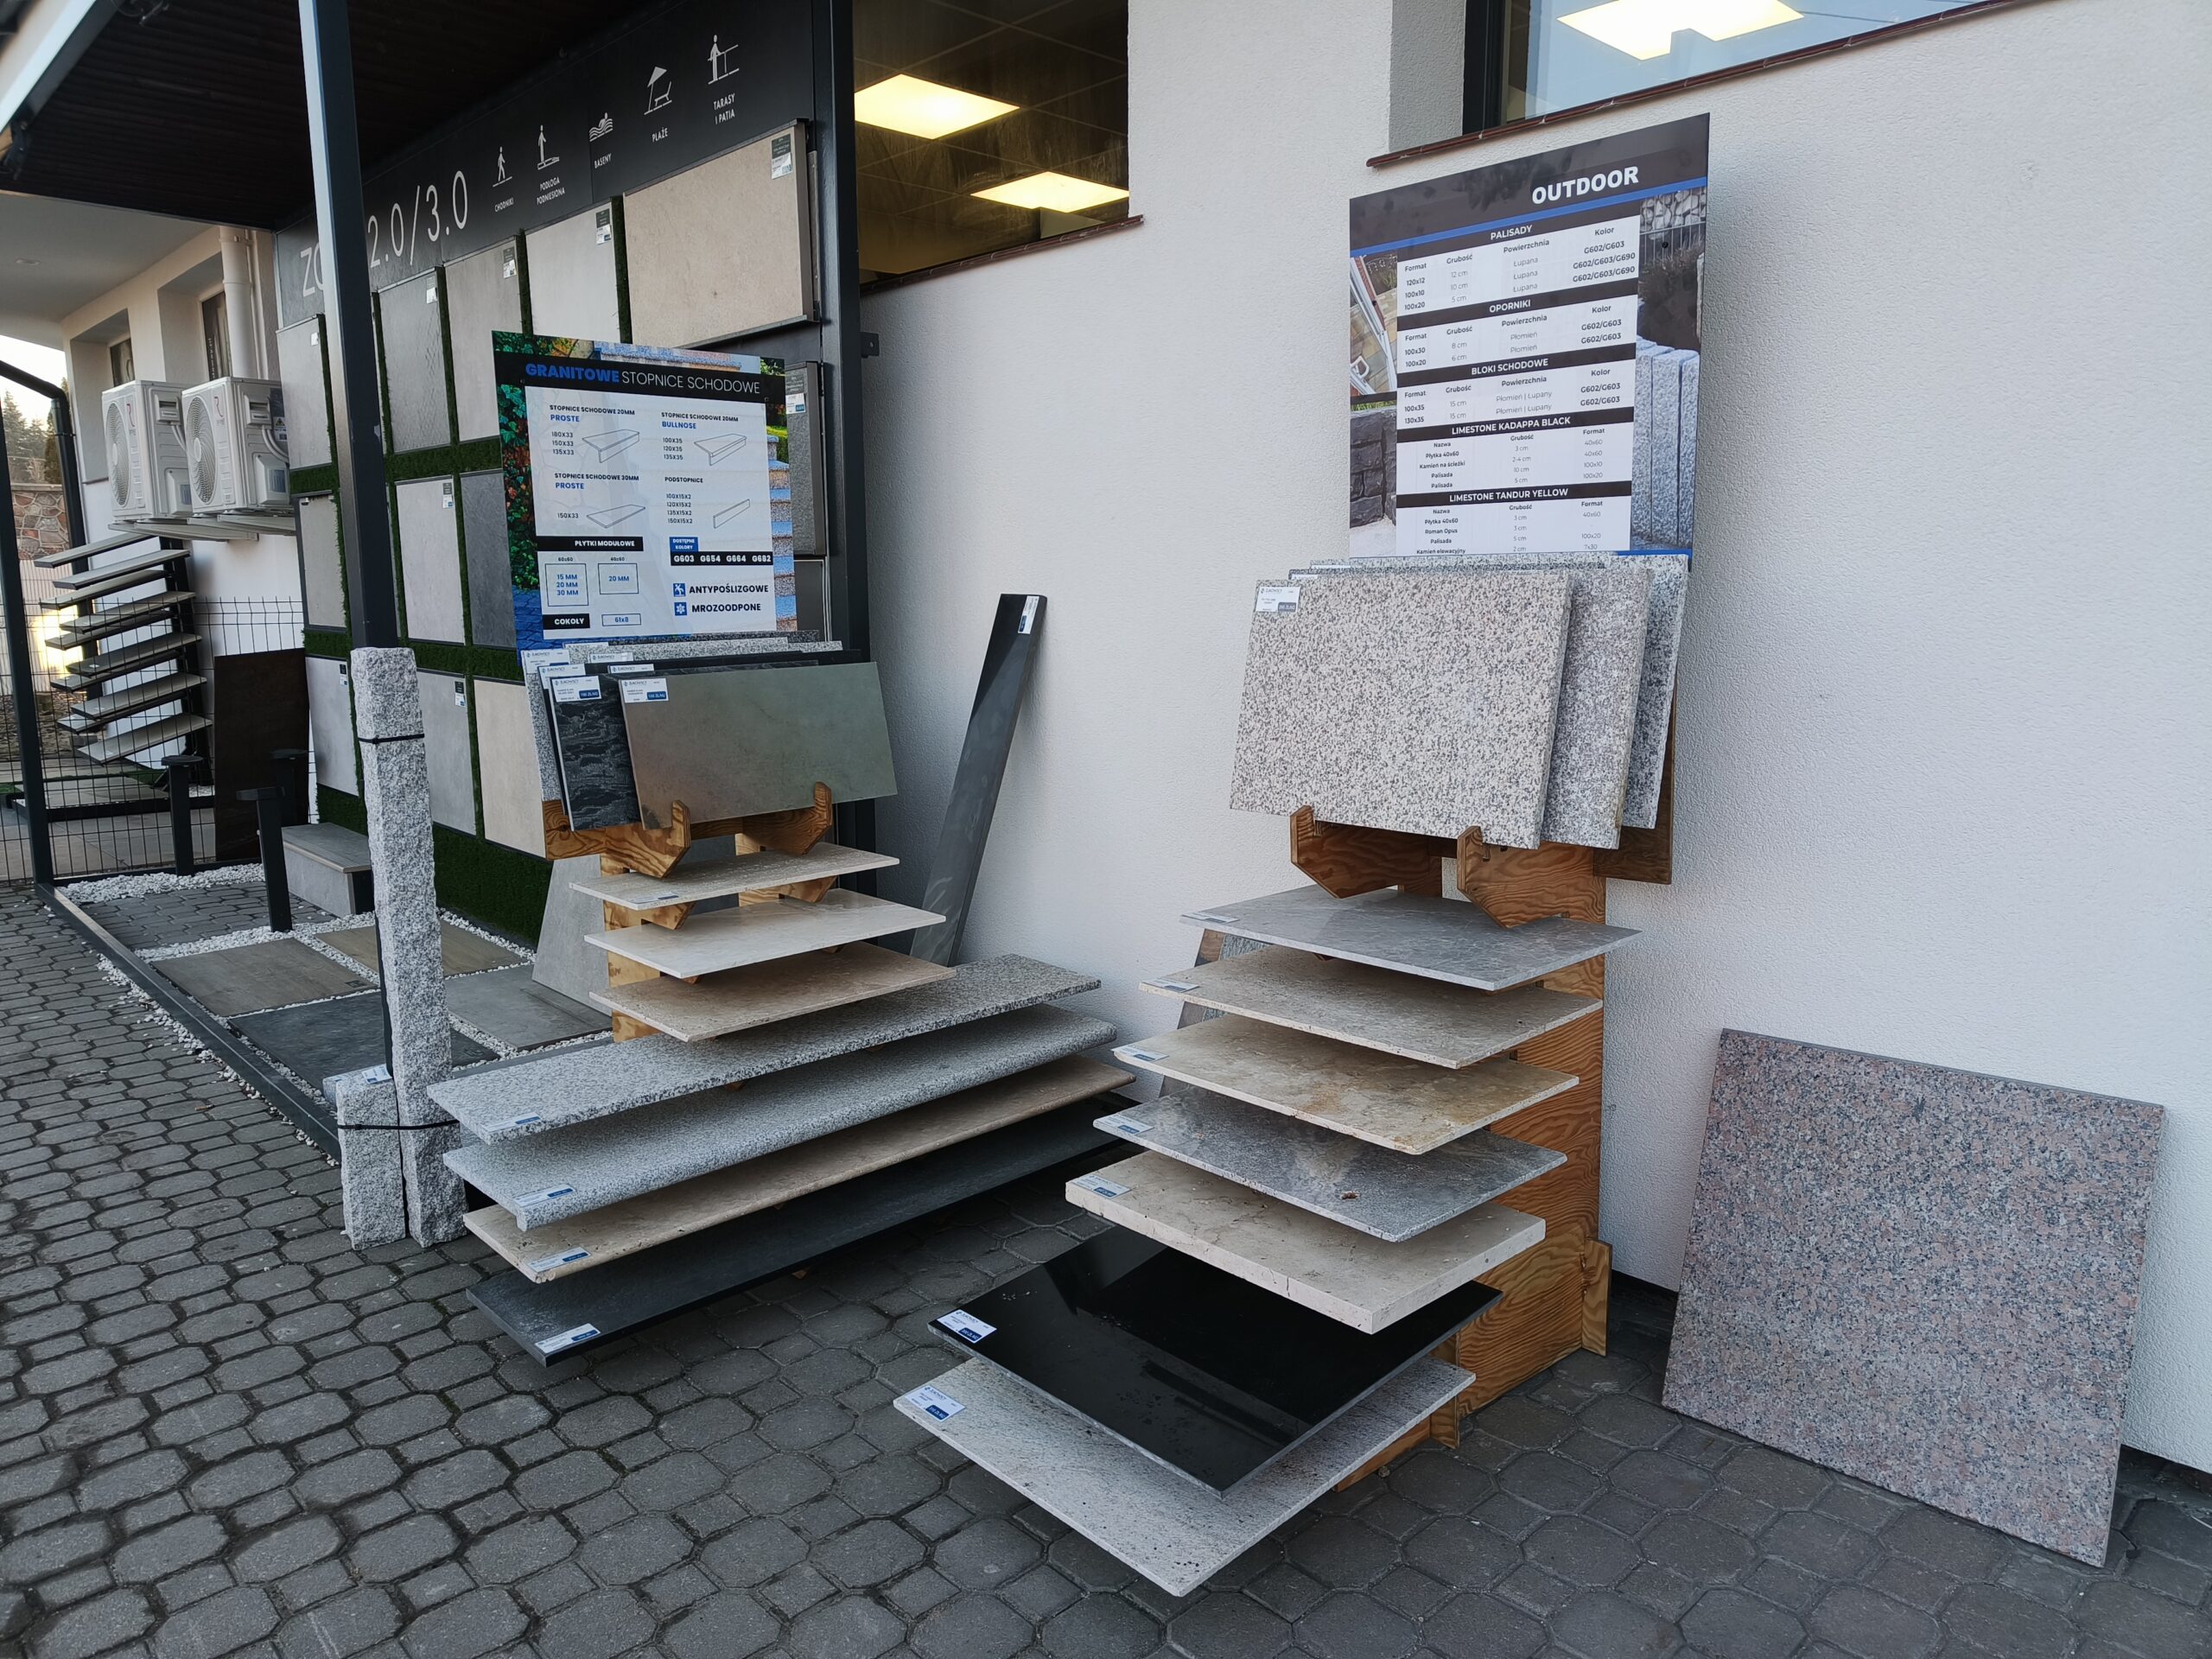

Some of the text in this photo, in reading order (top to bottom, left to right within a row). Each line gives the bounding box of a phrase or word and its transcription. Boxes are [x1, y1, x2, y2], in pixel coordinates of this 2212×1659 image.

[713, 92, 735, 110] TARASY
[719, 109, 735, 123] PATIA
[652, 127, 668, 143] PLAŻE
[594, 153, 611, 168] BASENY
[540, 177, 560, 191] PODŁOGA
[1532, 166, 1639, 204] OUTDOOR
[537, 187, 565, 205] PODNIESIONA
[495, 197, 514, 212] CHODNIKI
[368, 171, 467, 268] 2.0/3.0
[1491, 225, 1533, 240] PALISADY
[1595, 228, 1615, 236] Kolor
[1503, 239, 1550, 253] Powierzchnia
[1584, 241, 1625, 254] G602/G603
[1446, 254, 1473, 264] Grubość
[1513, 257, 1538, 267] Łupana
[1573, 252, 1636, 269] G602/G603/G690
[1405, 263, 1427, 272] Format
[1513, 270, 1538, 280] Łupana
[1573, 266, 1636, 283] G602/G603/G690
[1407, 277, 1425, 286] 120x12
[1513, 283, 1538, 293] Łupana
[1405, 290, 1425, 298] 100x10
[1405, 302, 1425, 310] 100x20
[1489, 299, 1531, 312] OPORNIKI
[1592, 305, 1611, 314] Kolor
[1502, 315, 1548, 327] Powierzchnia
[1581, 319, 1622, 331] G602/G603
[1446, 326, 1473, 335] Grubość
[1510, 331, 1538, 340] Płomień
[1405, 333, 1427, 341] Format
[1581, 333, 1621, 344] G602/G603
[1405, 347, 1425, 356] 100x30
[1406, 359, 1427, 367] 100x20
[1471, 358, 1549, 375] BLOKI SCHODOWE
[526, 363, 760, 394] GRANITOWE STOPNICE SCHODOWE
[1501, 376, 1547, 387] Powierzchnia
[1446, 385, 1471, 393] Grubość
[1581, 382, 1621, 393] G602/G603
[1580, 396, 1620, 407] G602/G603
[1452, 416, 1571, 435] LIMESTONE KADAPPA BLACK
[1449, 488, 1569, 502] LIMESTONE TANDUR YELLOW
[690, 585, 769, 594] ANTYPOŚLIZGOWE
[692, 604, 761, 613] MROZOODPONE
